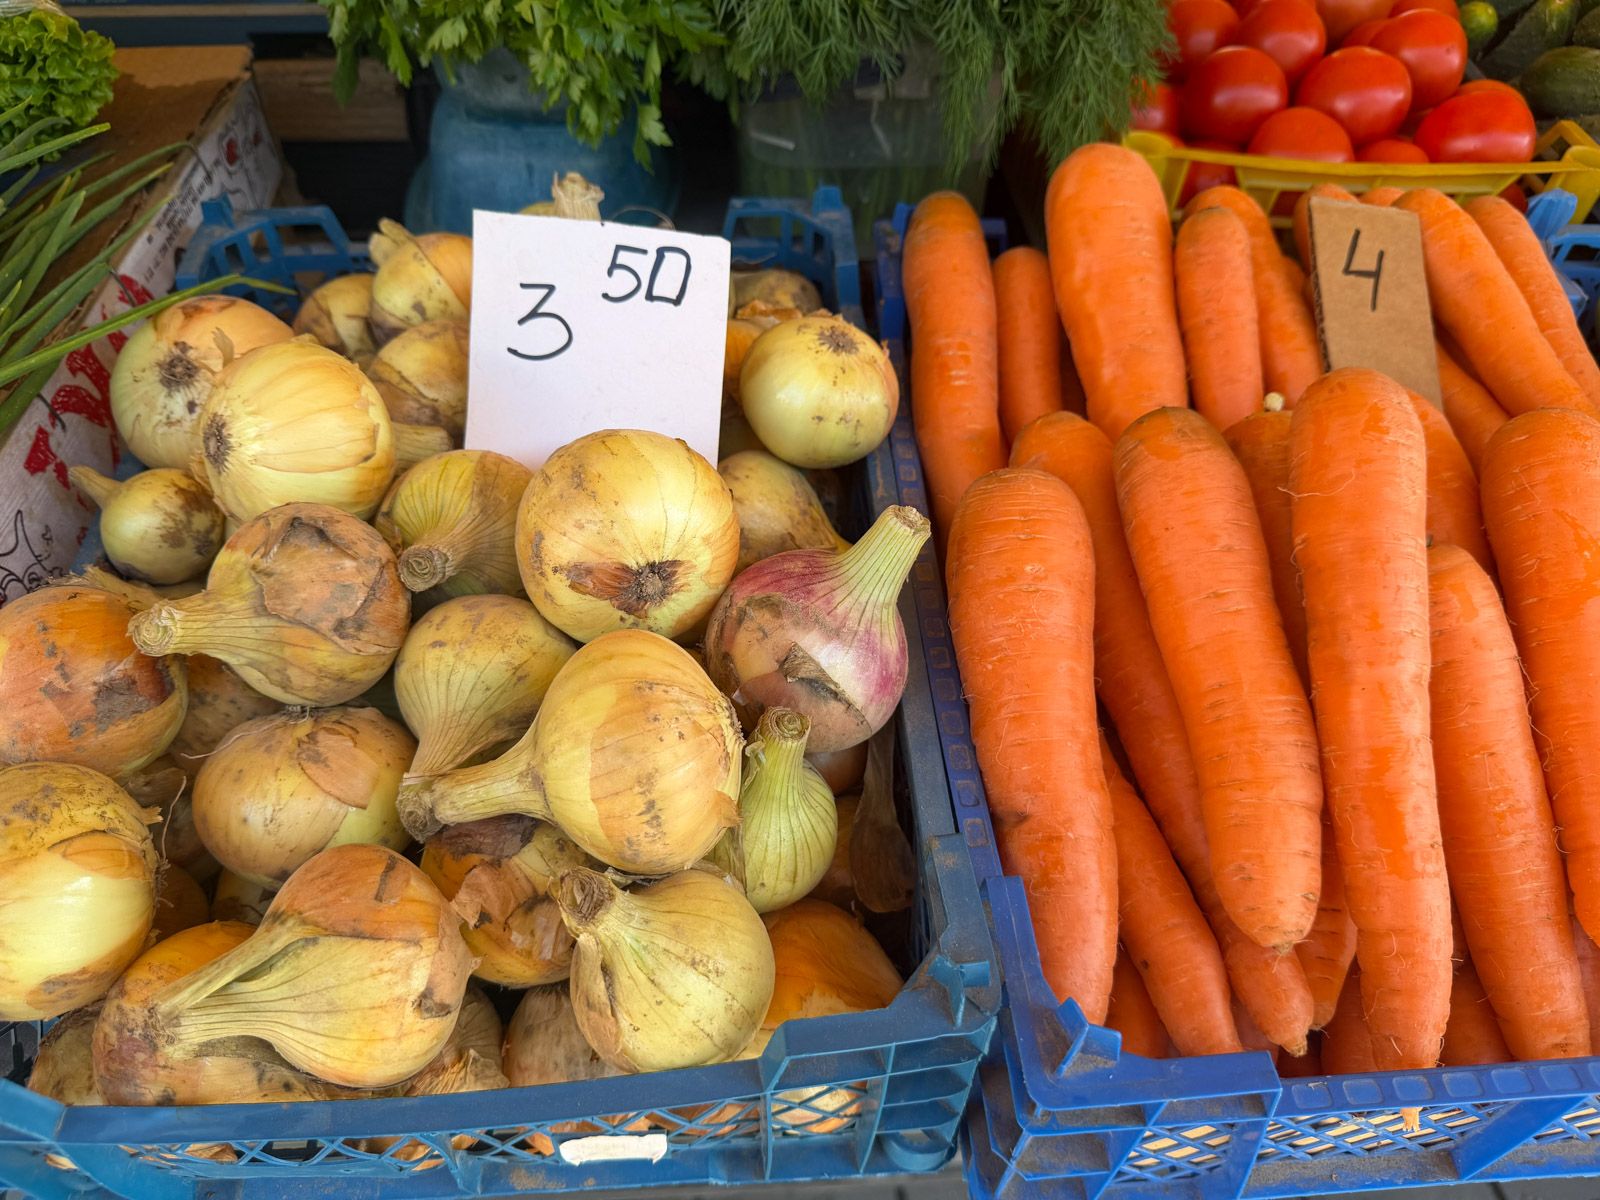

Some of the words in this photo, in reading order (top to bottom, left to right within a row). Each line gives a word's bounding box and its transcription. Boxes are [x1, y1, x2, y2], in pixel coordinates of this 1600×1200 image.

[507, 282, 573, 360] 3
[601, 244, 692, 306] 50
[1342, 228, 1384, 313] 4
